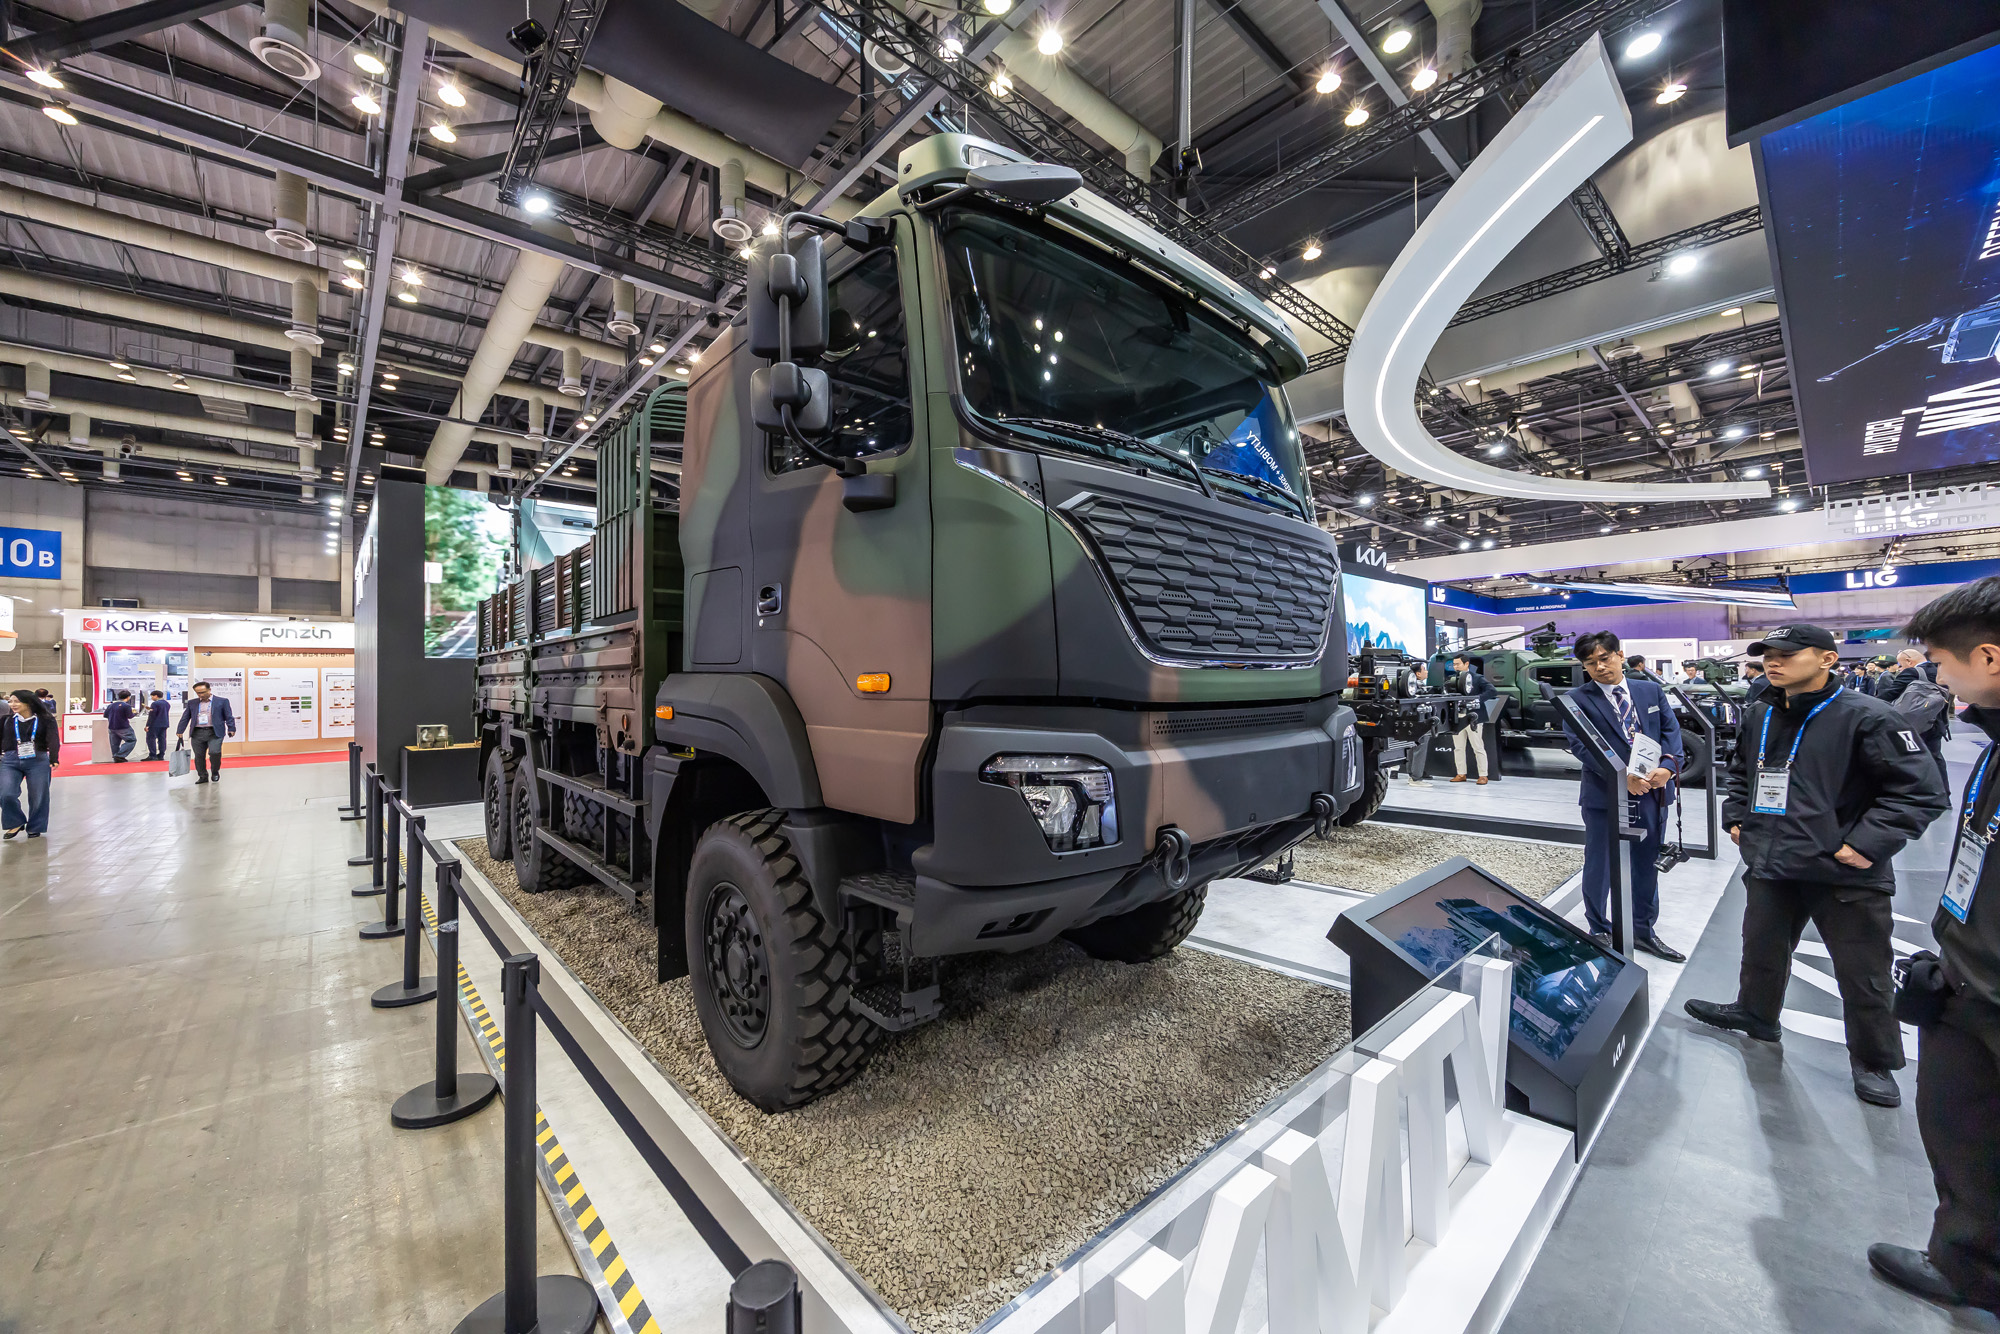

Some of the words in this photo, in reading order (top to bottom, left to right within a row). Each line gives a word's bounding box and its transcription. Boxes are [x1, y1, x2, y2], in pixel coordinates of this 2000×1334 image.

[1846, 569, 1898, 589] LIG
[1432, 587, 1446, 603] LIG
[106, 619, 174, 633] KOREA
[1703, 645, 1735, 657] LIG
